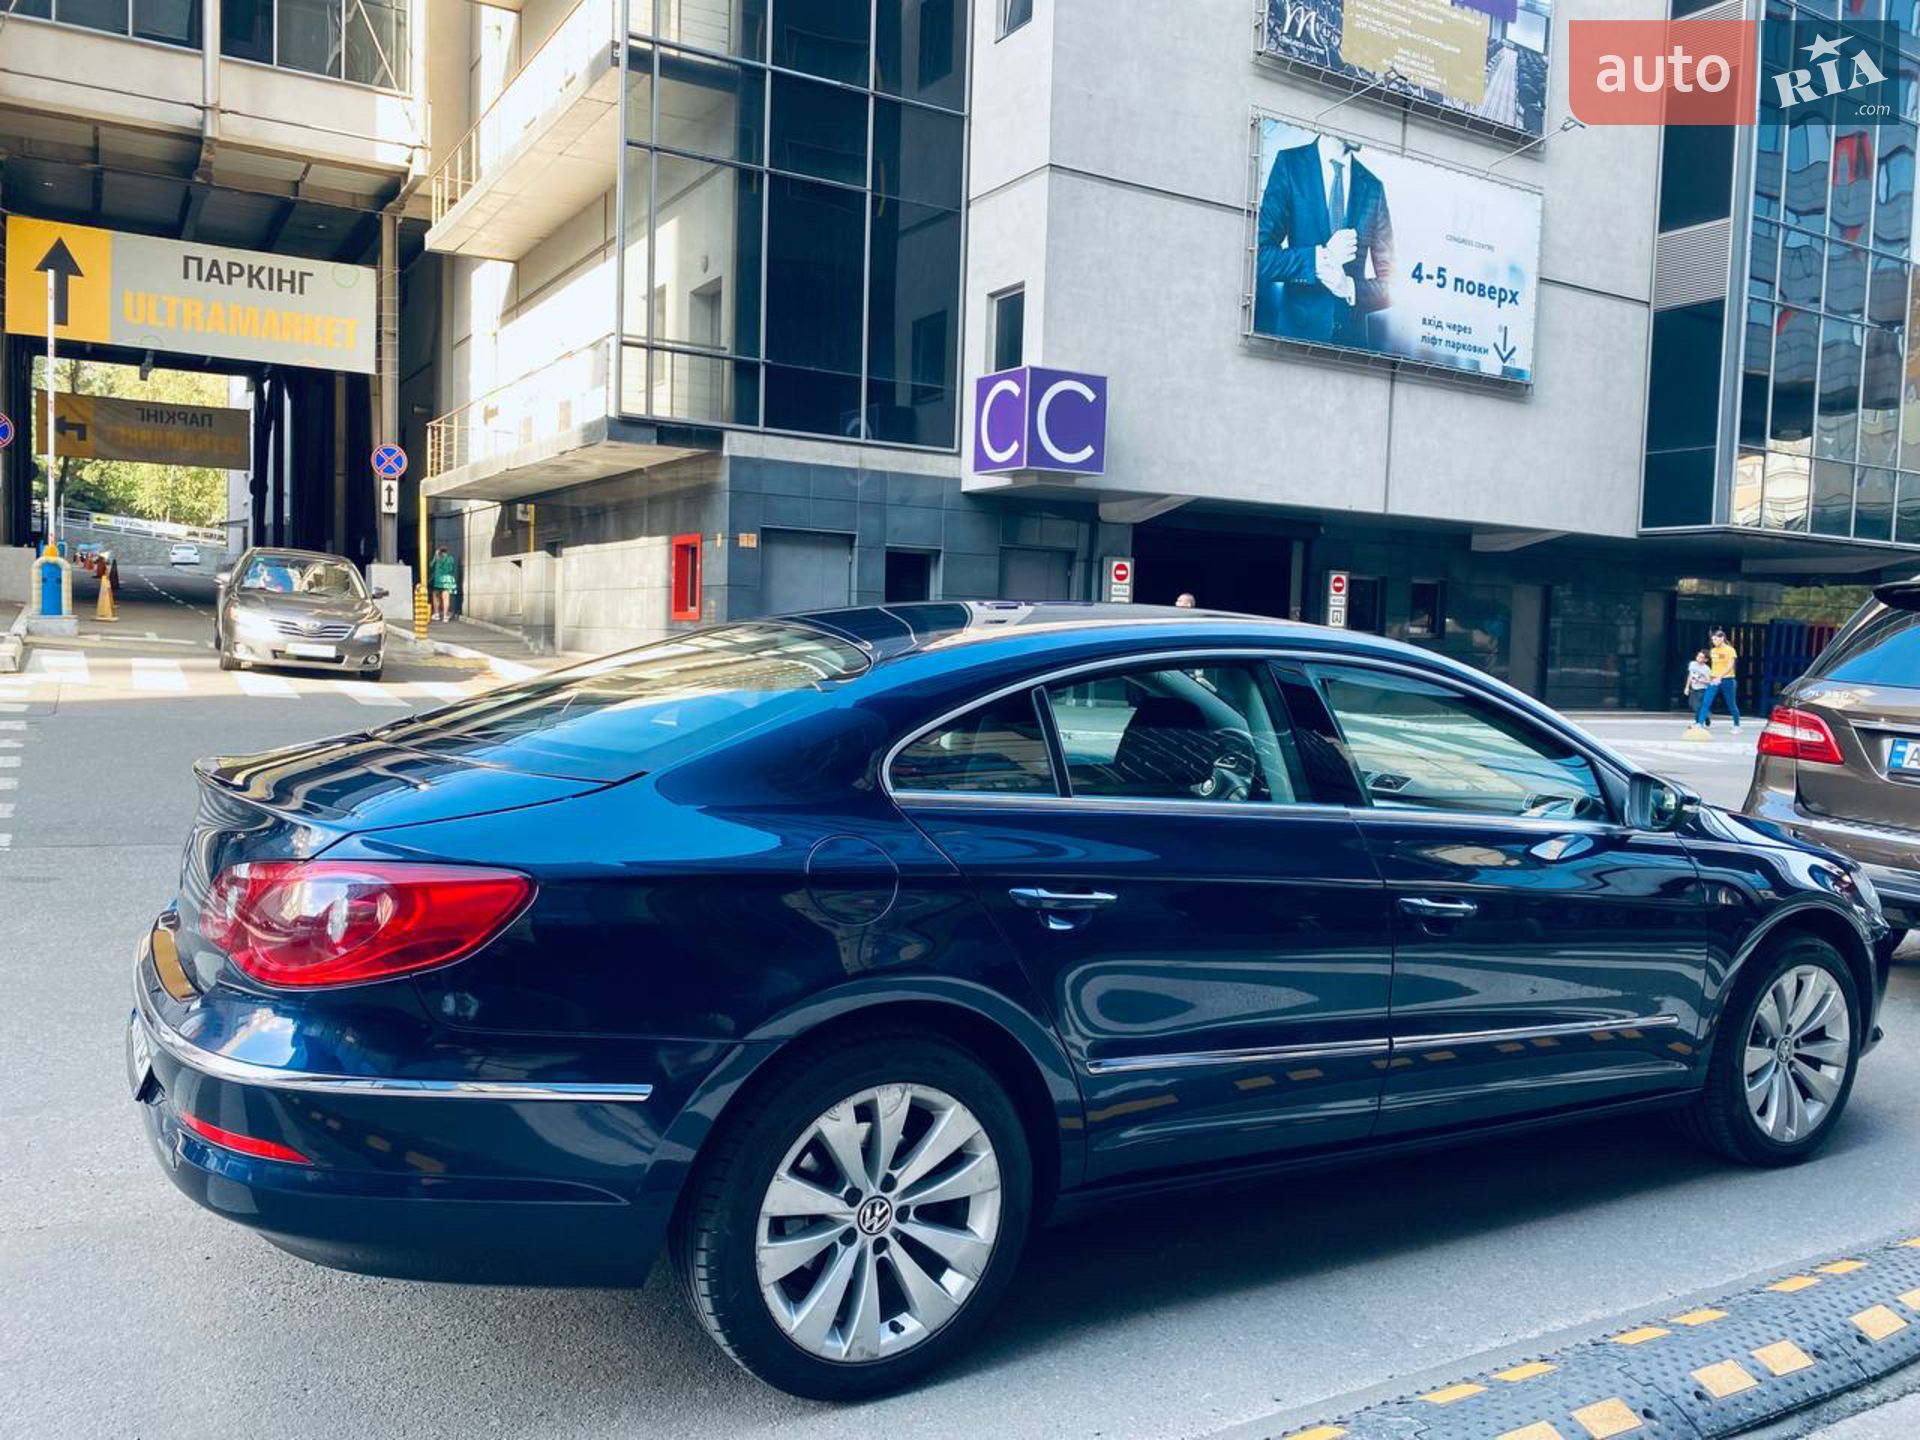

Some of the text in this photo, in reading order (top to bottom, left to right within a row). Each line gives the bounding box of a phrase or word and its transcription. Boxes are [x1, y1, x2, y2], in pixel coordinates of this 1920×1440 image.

[183, 255, 314, 295] ПАРКІНГ
[1411, 262, 1520, 309] 4-5 поверх
[123, 289, 360, 349] ULTRAMARKET
[1421, 315, 1473, 335] вхід через
[1421, 332, 1489, 355] ліфт парковки
